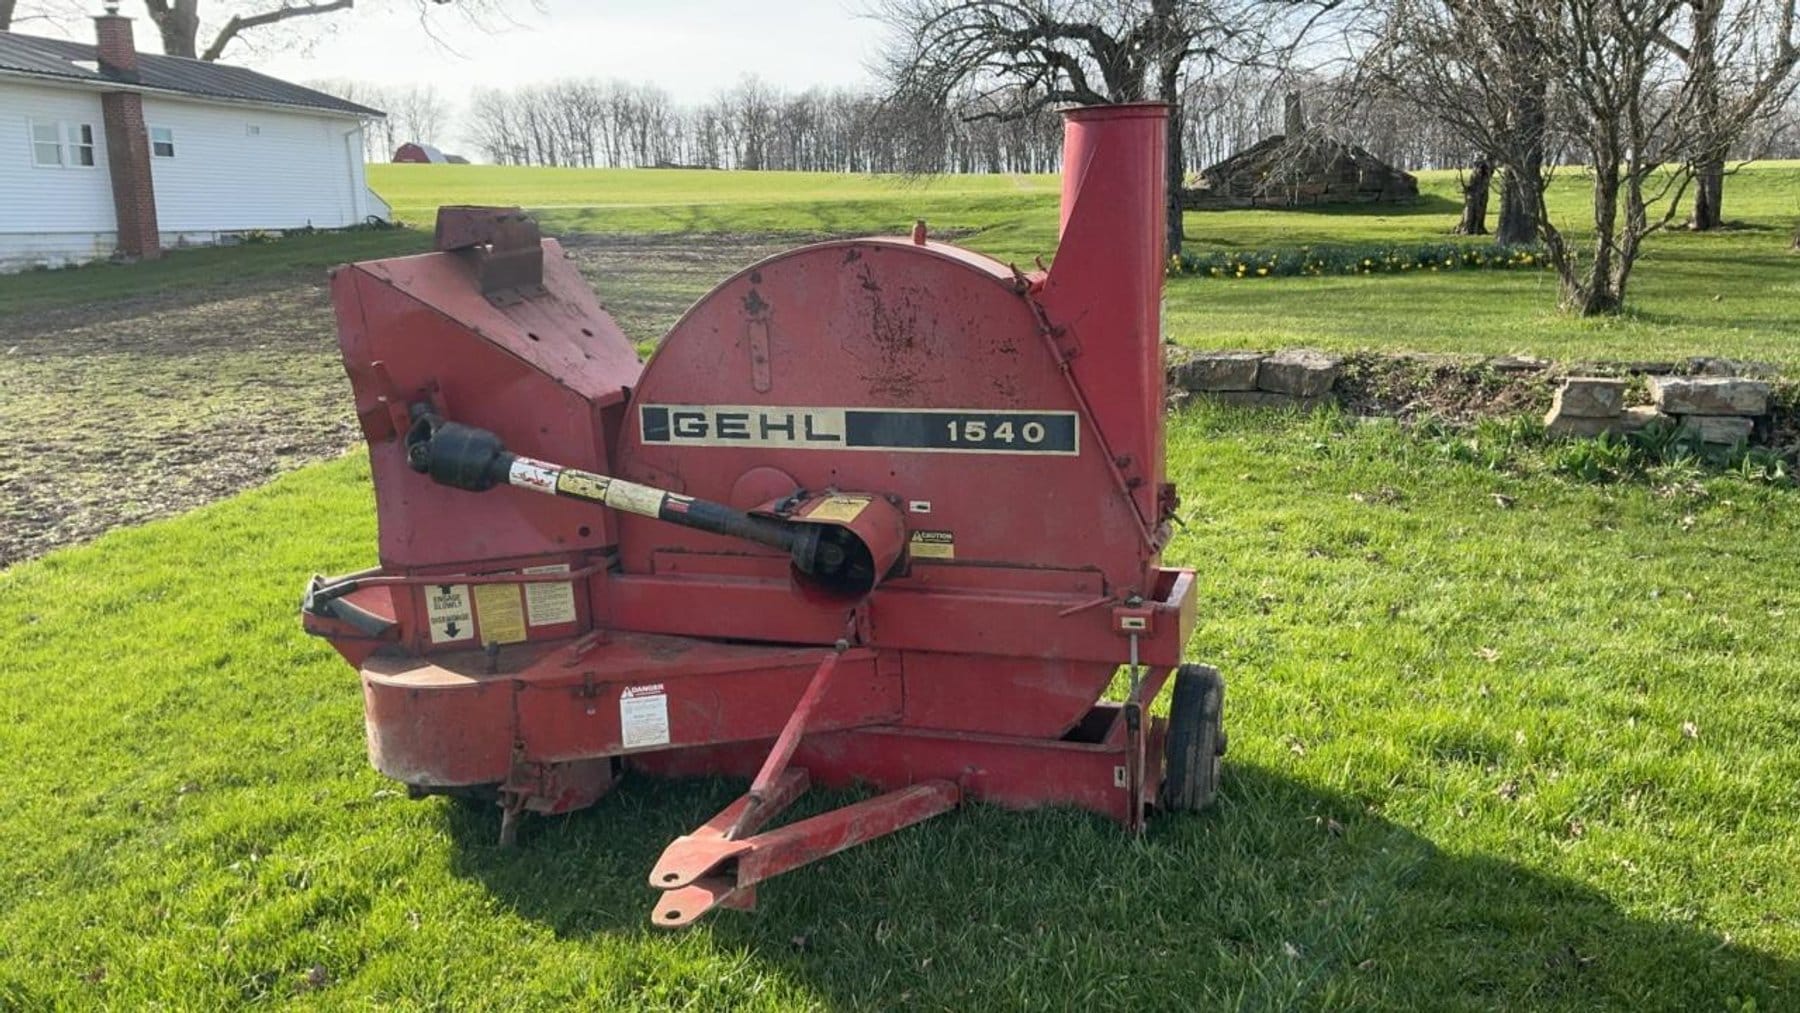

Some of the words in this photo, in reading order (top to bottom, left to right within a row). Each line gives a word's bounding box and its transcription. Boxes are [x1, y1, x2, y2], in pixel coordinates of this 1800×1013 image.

[673, 412, 840, 441] GEHL
[947, 420, 1045, 443] 1540
[921, 531, 952, 539] CAUTION
[433, 594, 461, 603] ENGAGE
[433, 601, 462, 610] SLOWLY
[632, 683, 664, 692] DANGER
